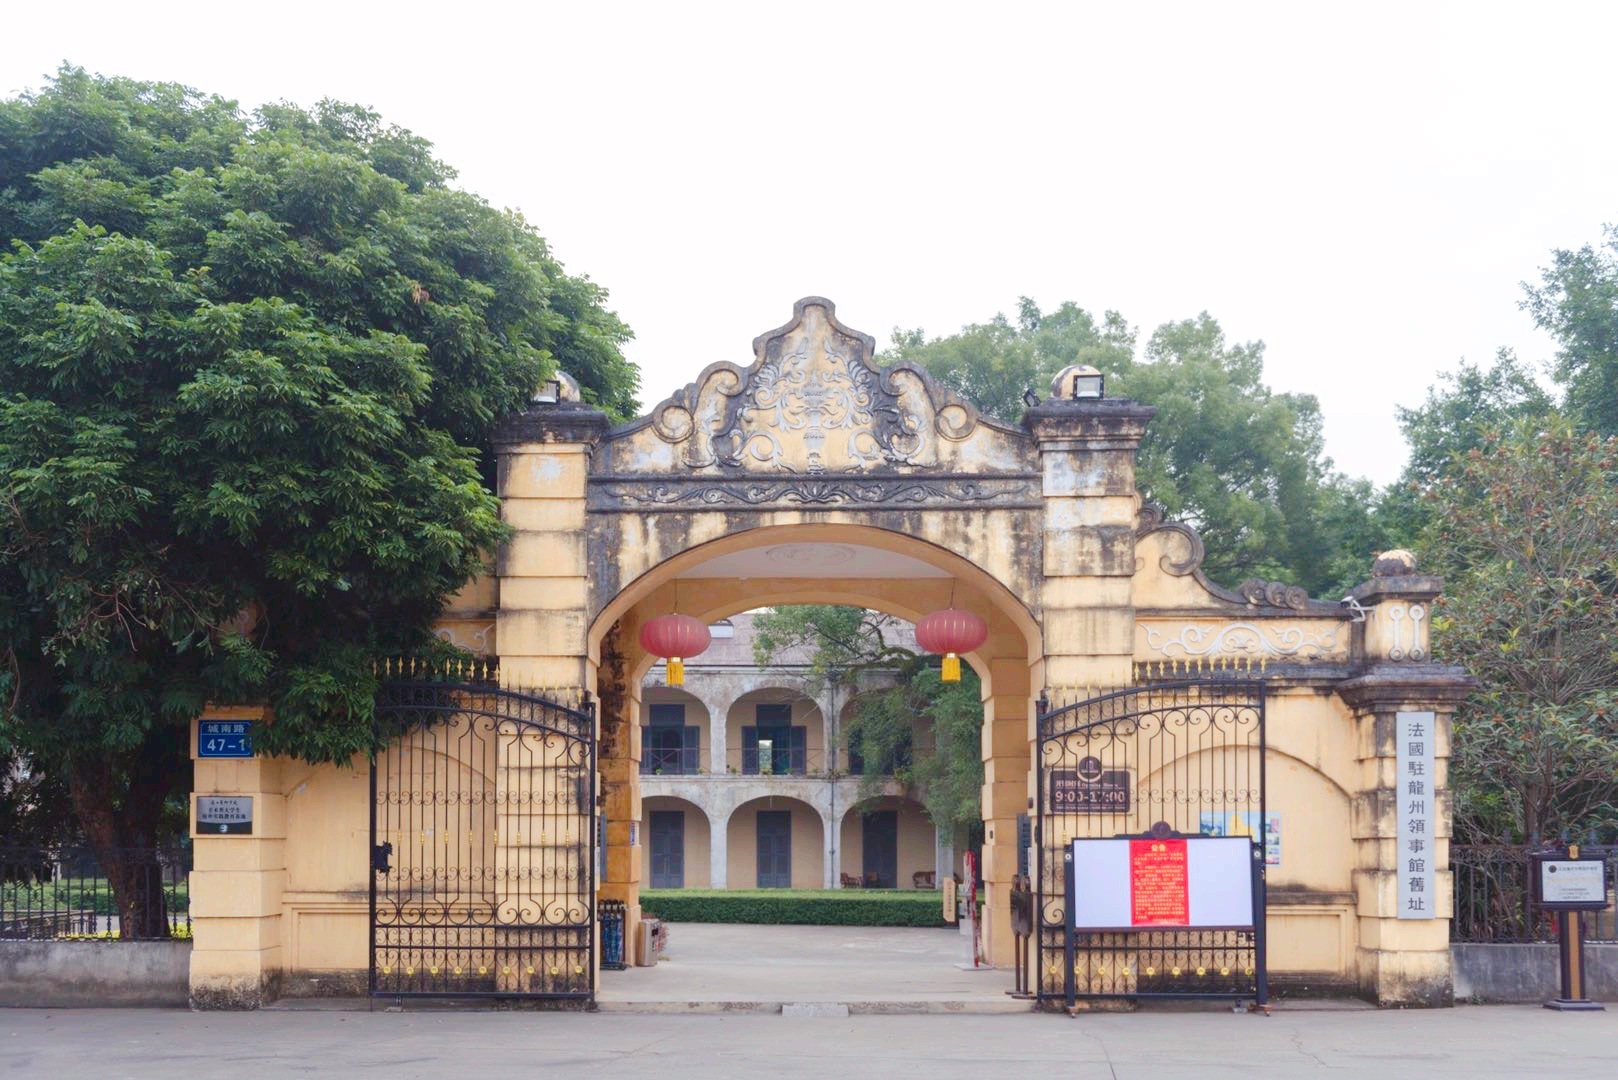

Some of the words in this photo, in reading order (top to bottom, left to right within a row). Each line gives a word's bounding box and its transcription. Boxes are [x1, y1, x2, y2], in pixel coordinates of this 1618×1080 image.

[208, 724, 245, 733] 城南路
[207, 738, 245, 751] 47-1
[1408, 722, 1424, 911] 法國駐龍州領事館舊址
